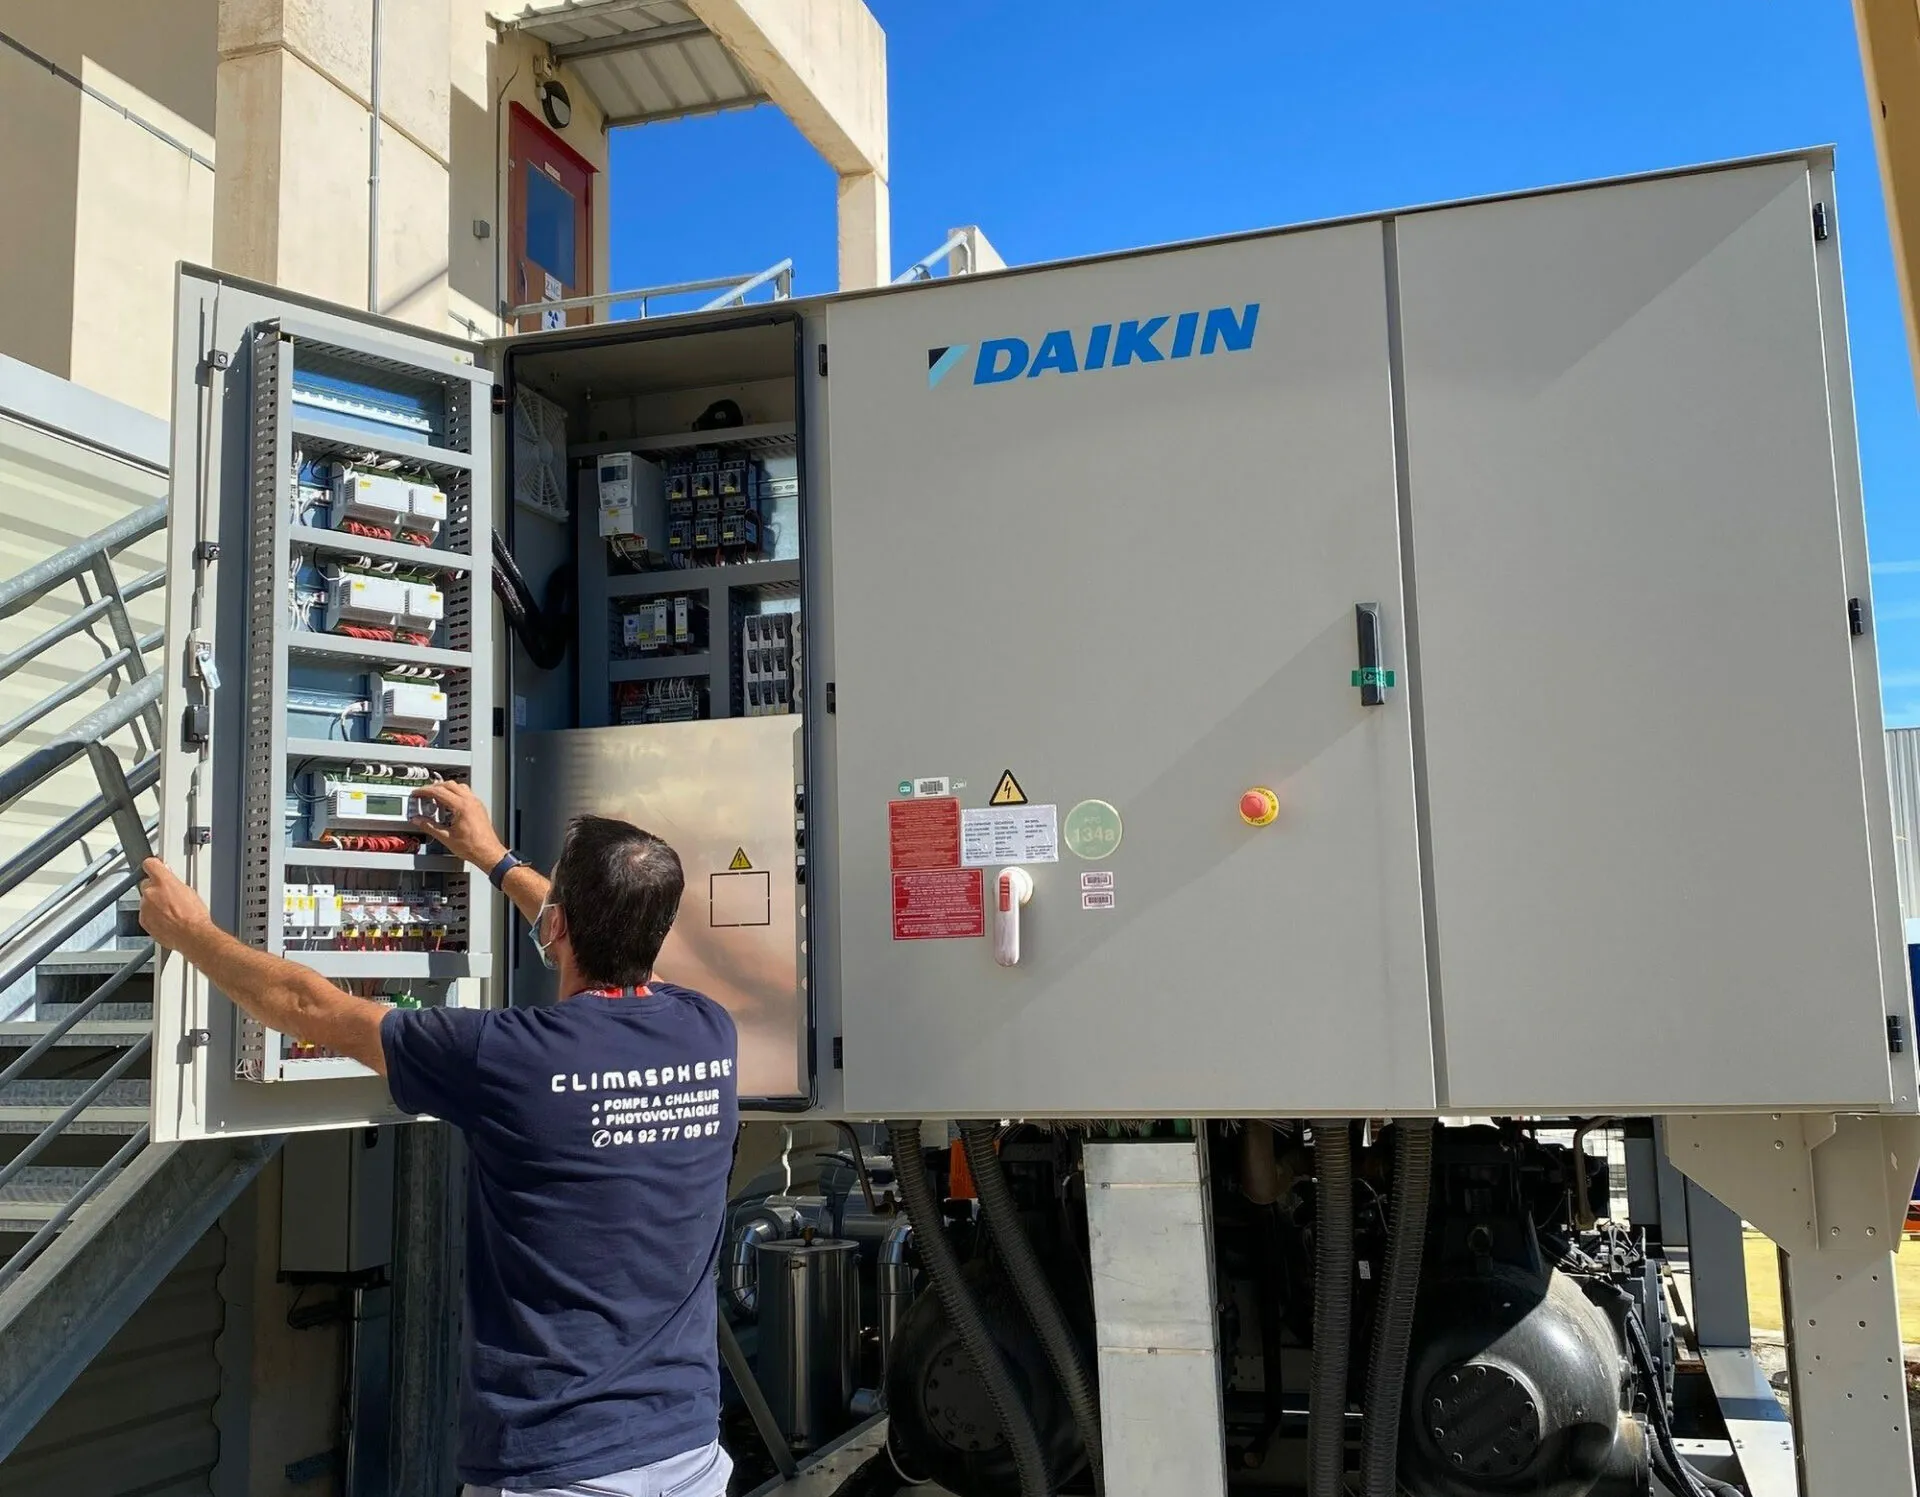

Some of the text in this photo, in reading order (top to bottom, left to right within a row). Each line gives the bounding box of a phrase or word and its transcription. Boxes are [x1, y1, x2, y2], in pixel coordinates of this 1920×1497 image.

[973, 303, 1260, 385] DAIKIN
[1071, 826, 1115, 843] 134a
[604, 1089, 720, 1112] POMPE A CHALEUR
[606, 1103, 719, 1126] PHOTOVOLTAIQUE
[613, 1121, 720, 1145] 04 92 77 09 67
